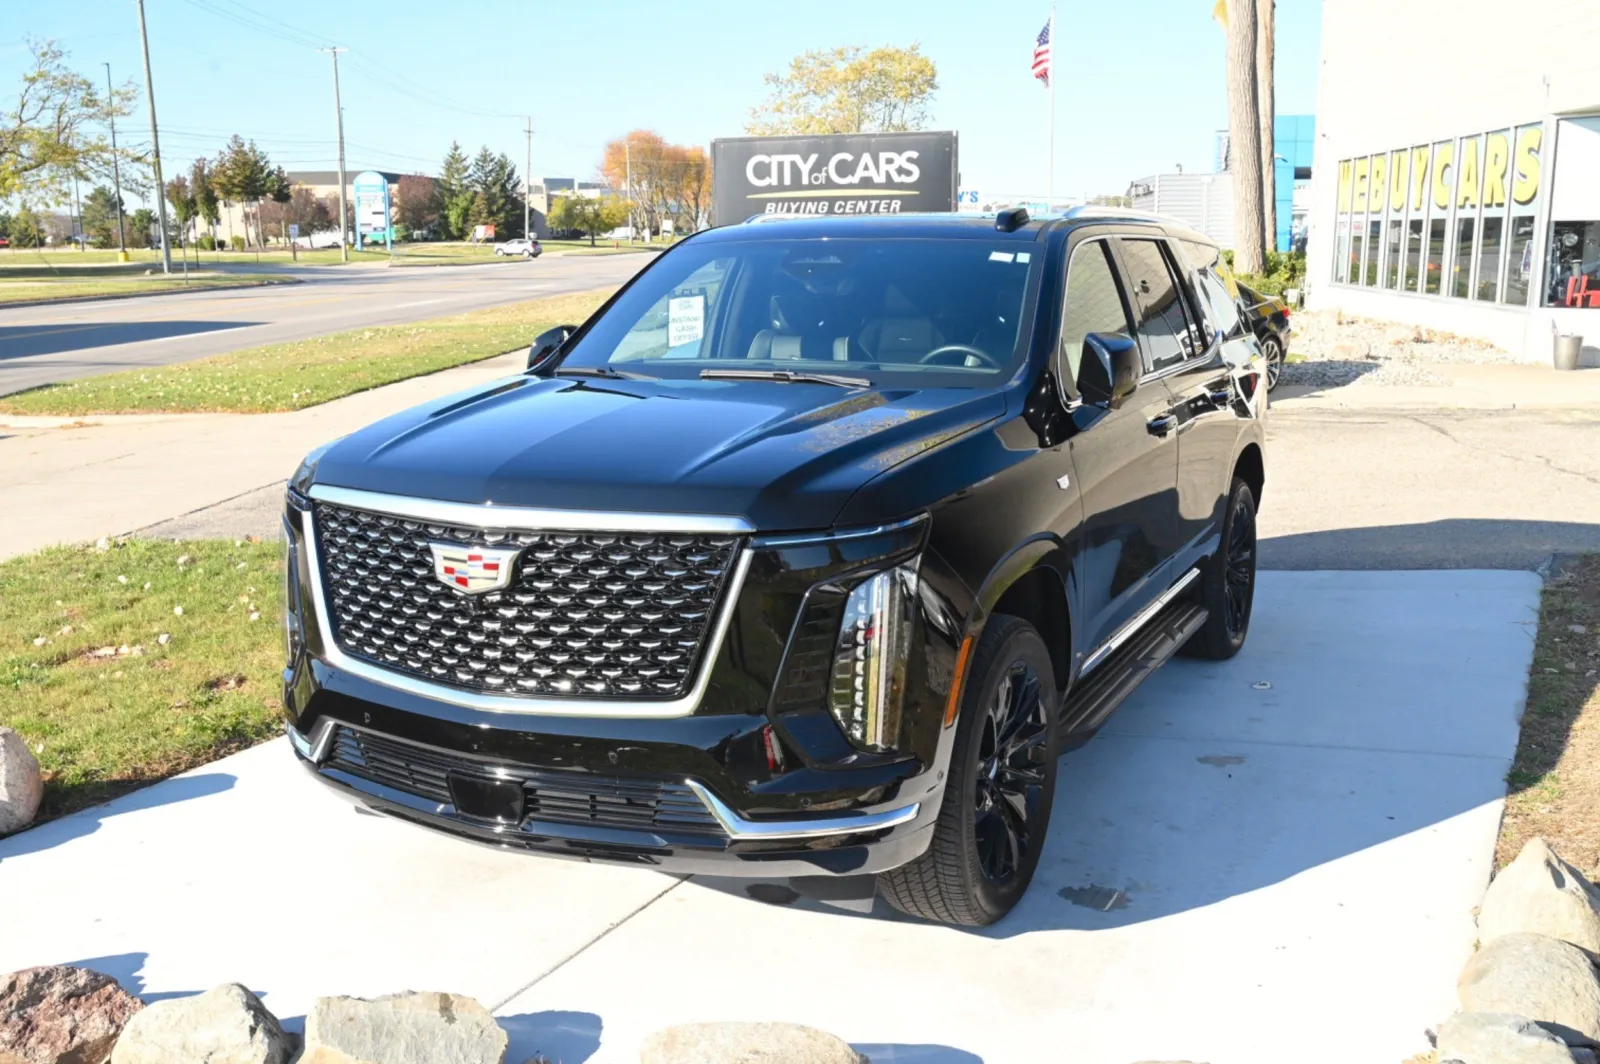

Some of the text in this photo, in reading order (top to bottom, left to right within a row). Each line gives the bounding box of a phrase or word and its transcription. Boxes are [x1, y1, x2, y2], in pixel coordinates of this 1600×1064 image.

[746, 150, 921, 187] CITY of CARS
[764, 199, 902, 214] BUYING CENTER
